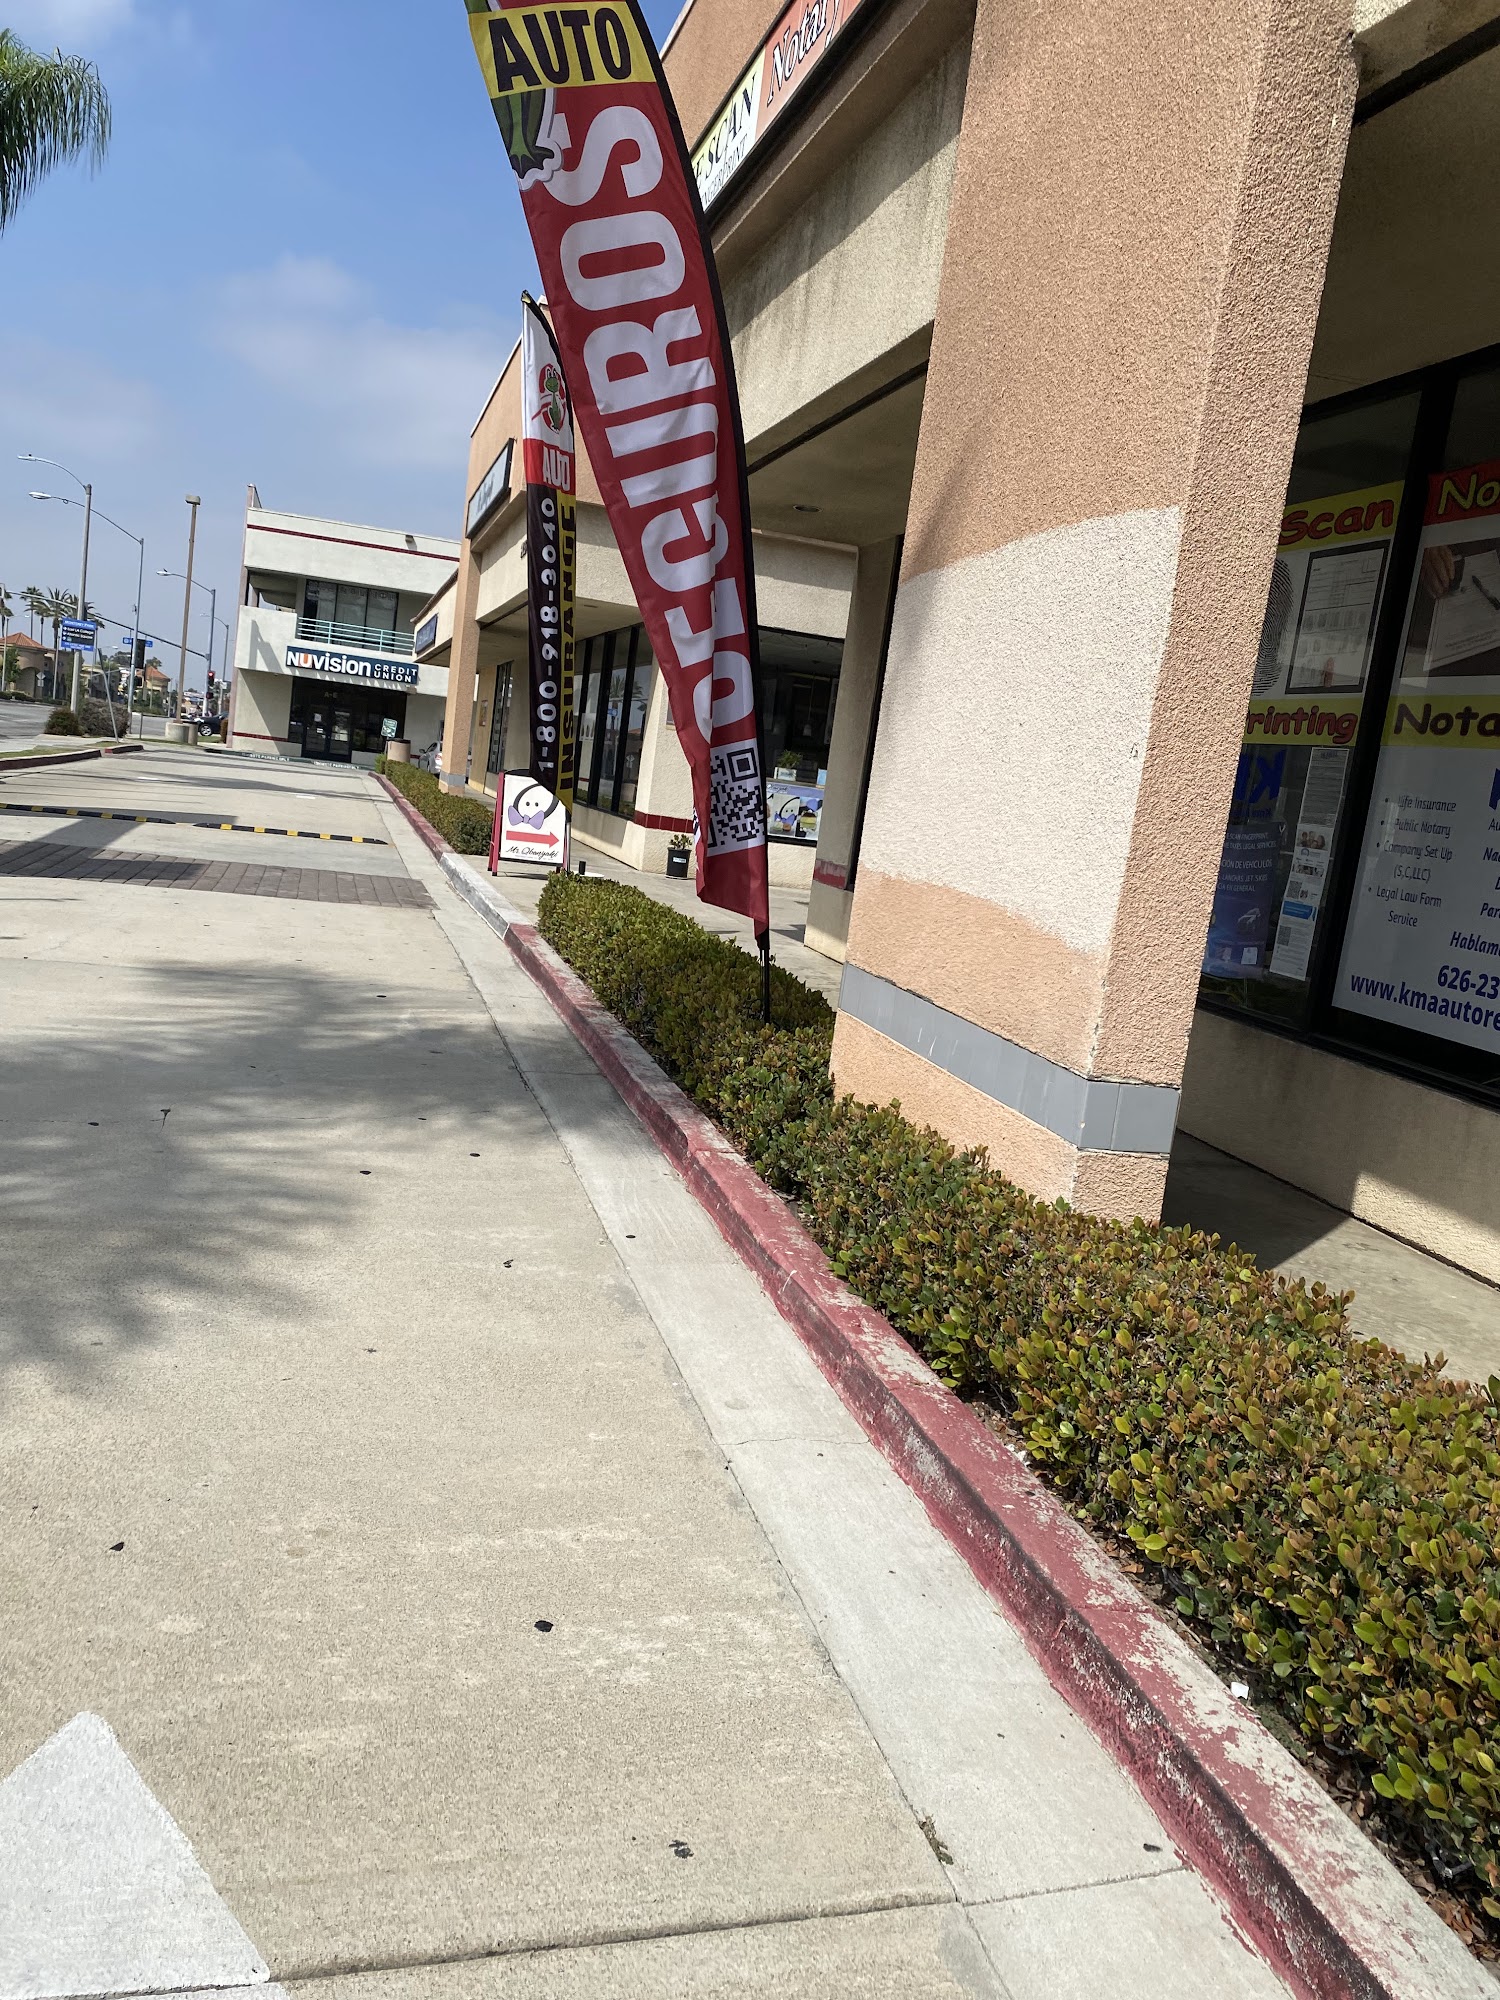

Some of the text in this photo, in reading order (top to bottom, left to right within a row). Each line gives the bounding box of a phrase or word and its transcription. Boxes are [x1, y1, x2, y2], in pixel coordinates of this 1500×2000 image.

[488, 7, 632, 92] AUTO
[766, 0, 840, 108] Notary
[705, 72, 757, 180] SCAN
[1278, 499, 1395, 546] Scan
[536, 497, 558, 772] 1-800-918-3040
[559, 502, 575, 791] INSURANCE
[373, 671, 412, 683] UNION
[374, 663, 417, 677] CREDIT
[1246, 705, 1359, 744] rinting
[1393, 703, 1500, 737] Nota
[1415, 796, 1457, 812] Insurance
[1395, 817, 1451, 838] Public Notary
[1383, 840, 1453, 863] Company Set Up
[1376, 885, 1442, 908] Legal Law Form
[1387, 910, 1418, 927] Service
[1437, 965, 1500, 999] 626-23
[1351, 974, 1500, 1031] www.kmaautore
